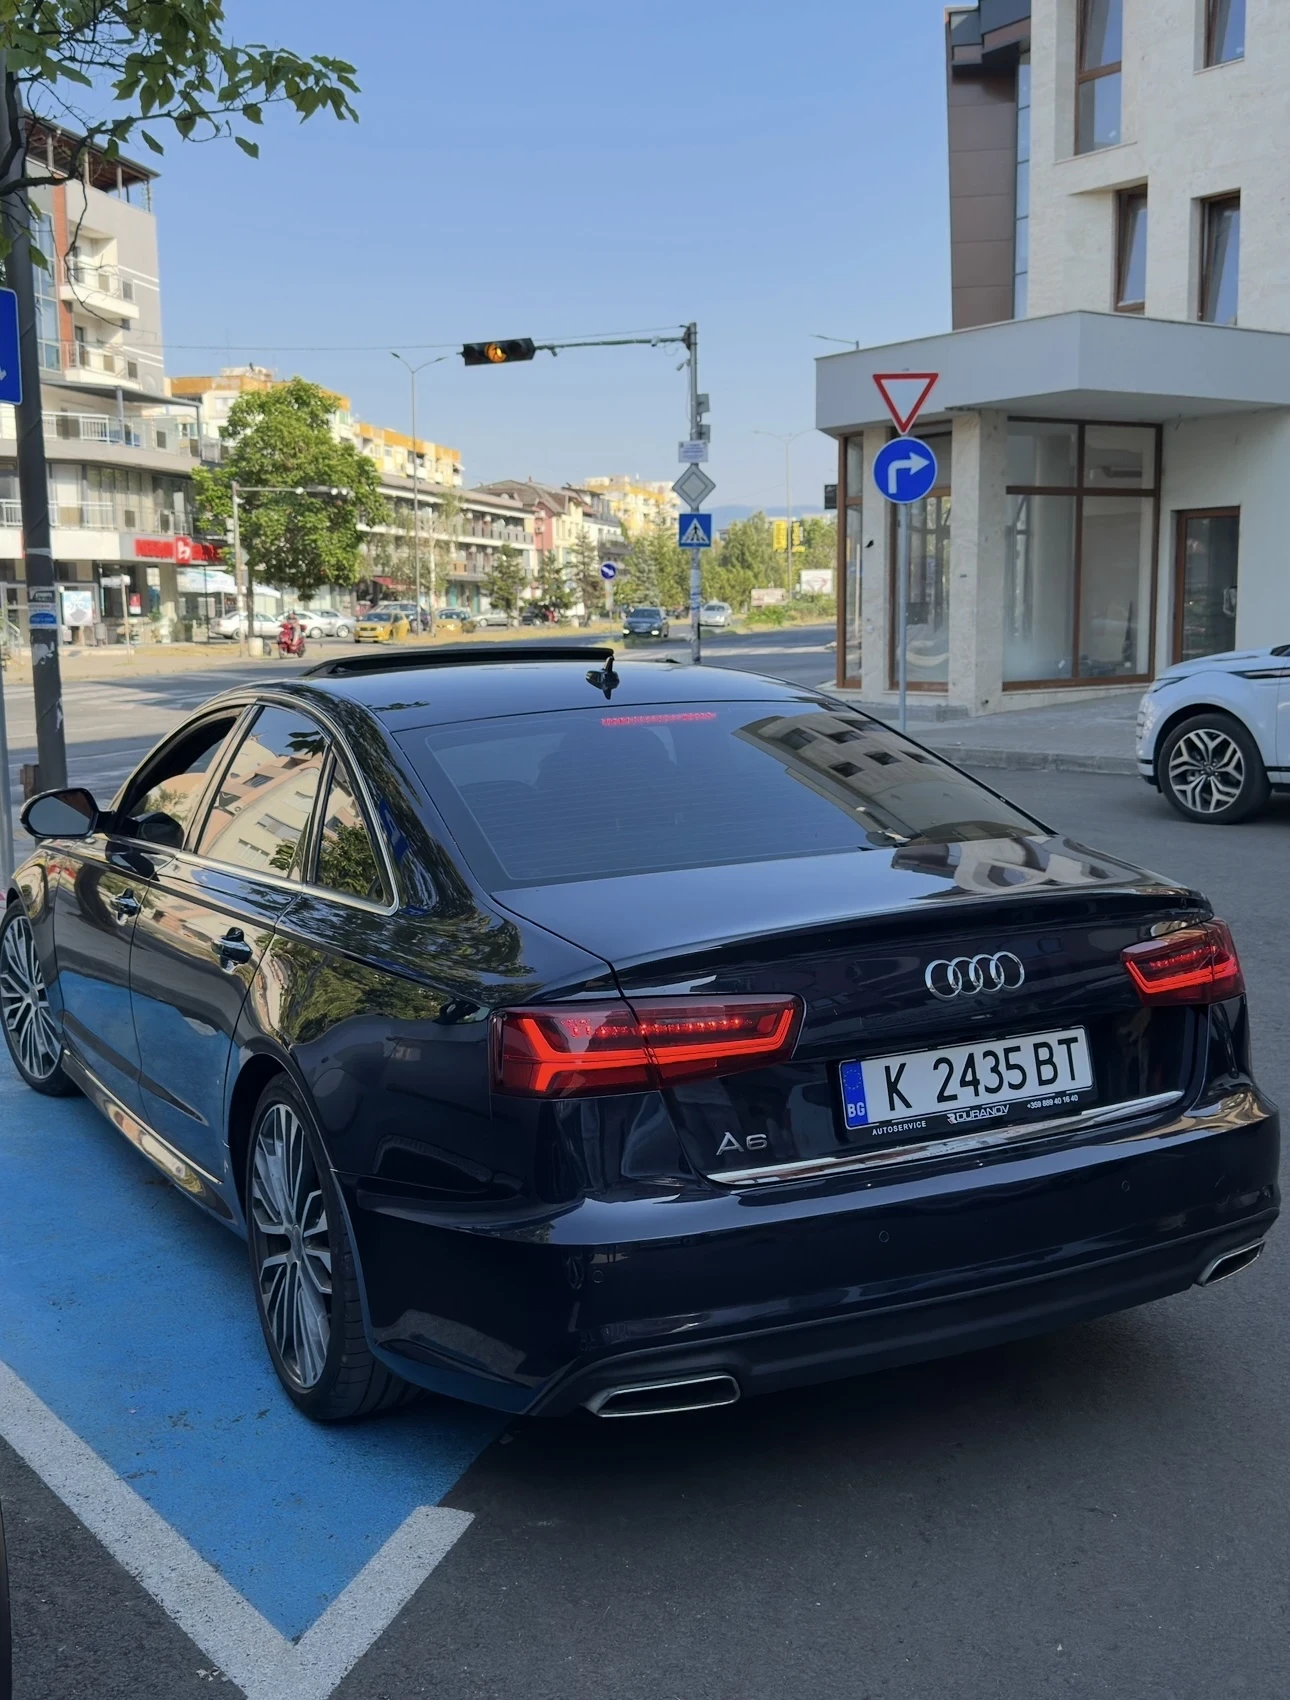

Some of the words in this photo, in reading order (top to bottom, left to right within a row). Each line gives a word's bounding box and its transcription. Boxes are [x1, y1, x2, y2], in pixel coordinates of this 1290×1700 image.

[847, 1101, 866, 1118] BG
[872, 1120, 927, 1136] AUTOSERVICE
[716, 1131, 768, 1156] A6
